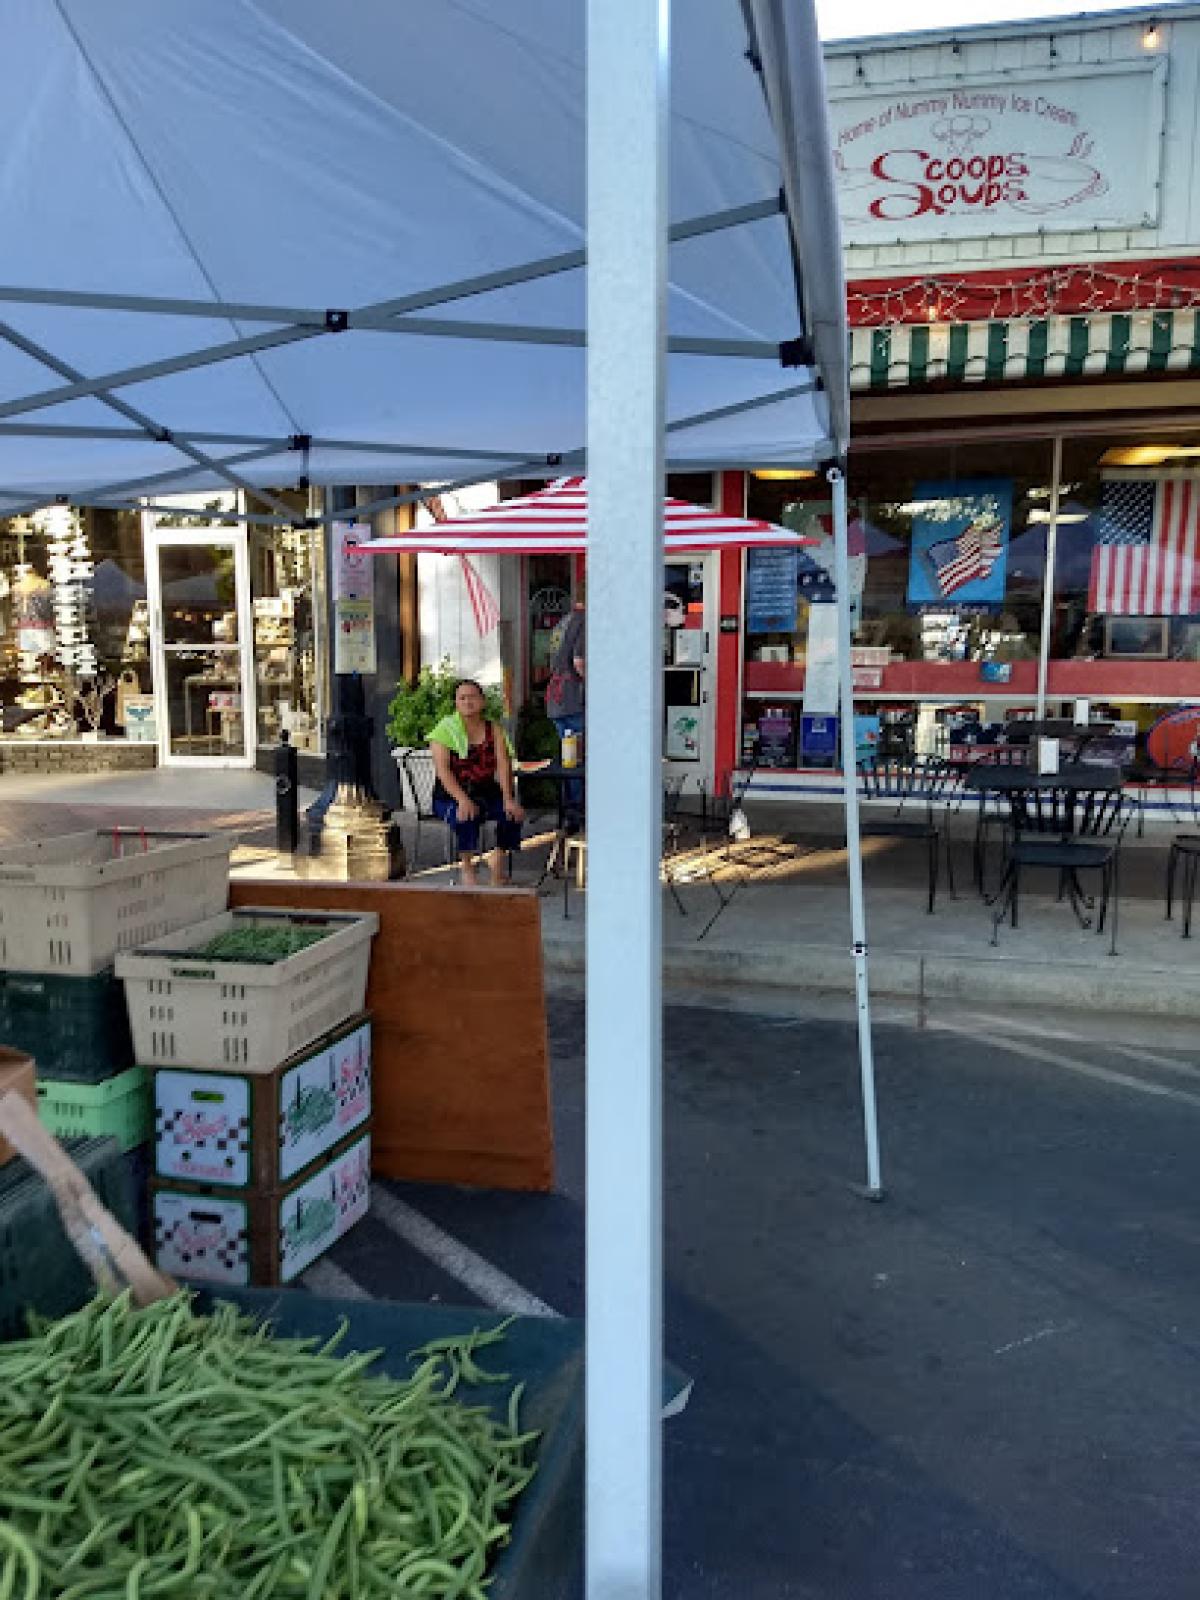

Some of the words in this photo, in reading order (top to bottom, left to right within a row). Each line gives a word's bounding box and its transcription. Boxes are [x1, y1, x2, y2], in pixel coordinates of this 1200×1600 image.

[838, 118, 877, 147] Home
[878, 106, 893, 128] of
[1012, 93, 1033, 113] Ice
